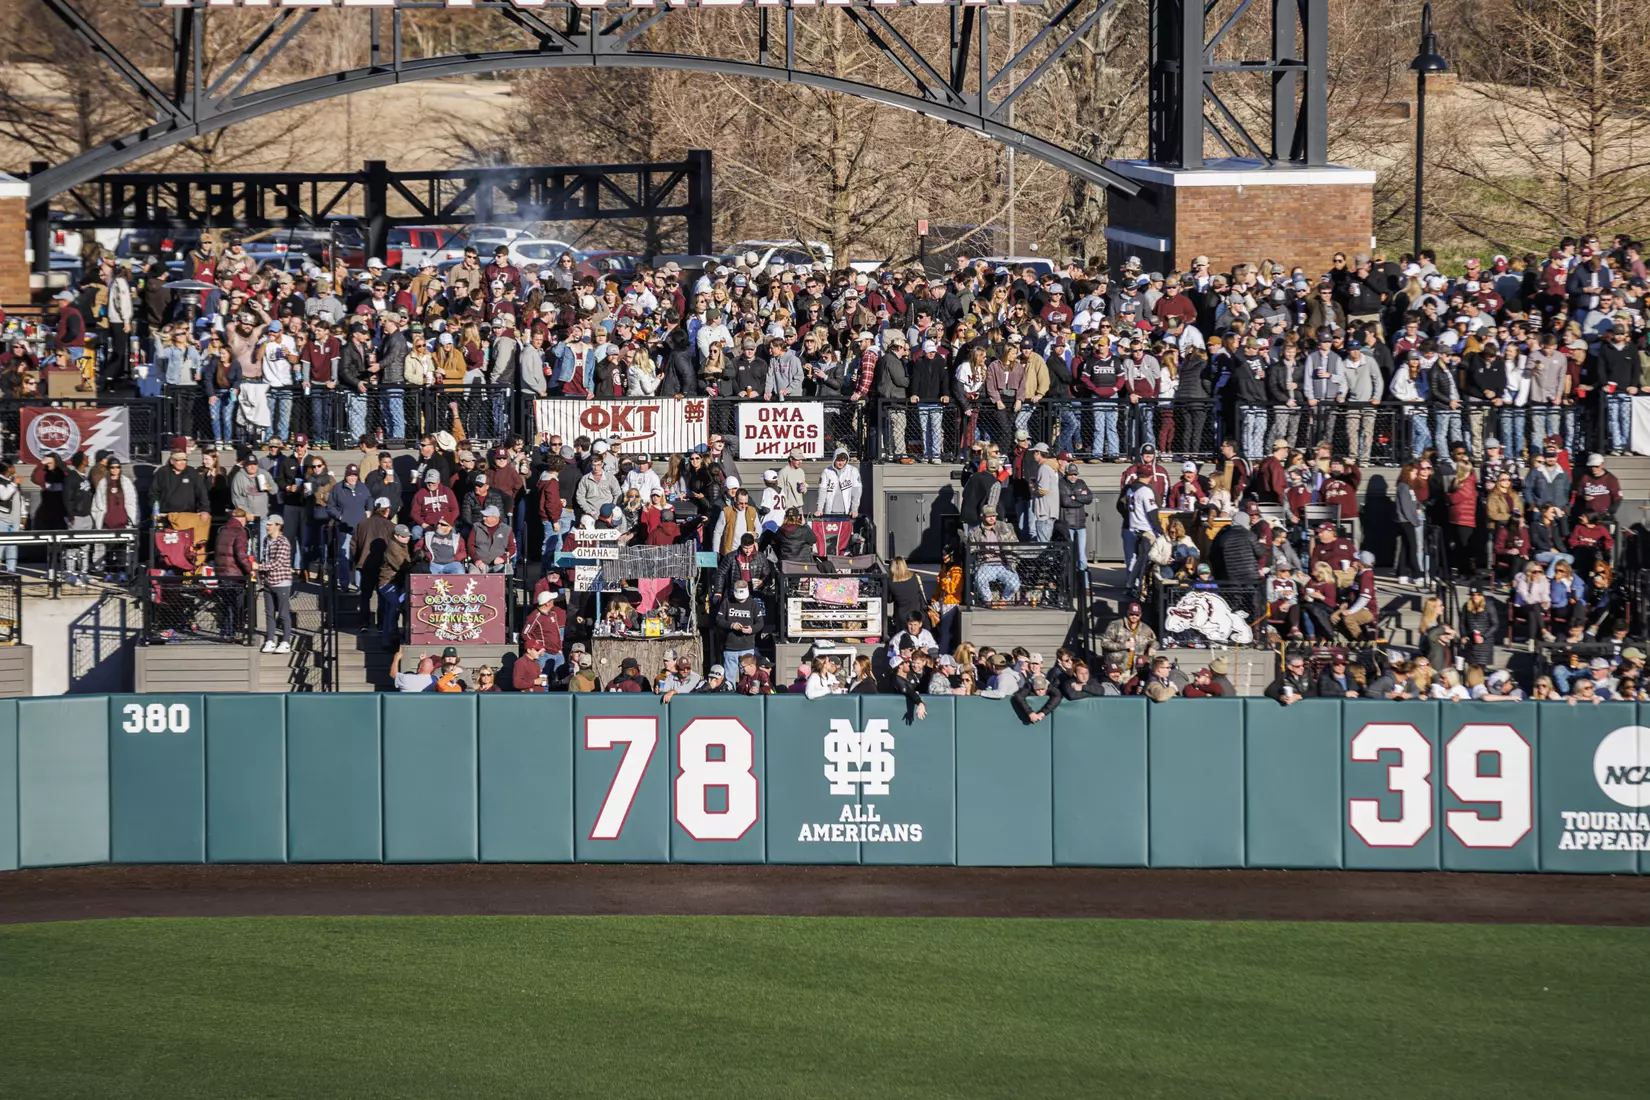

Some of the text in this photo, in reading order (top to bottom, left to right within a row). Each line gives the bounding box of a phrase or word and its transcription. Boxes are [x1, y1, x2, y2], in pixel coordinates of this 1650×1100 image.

[758, 407, 804, 422] OMA
[745, 424, 819, 440] DAWGS
[579, 531, 607, 539] Hoover
[577, 549, 609, 557] OMAHA
[429, 613, 485, 623] STARKVEGAS
[122, 703, 190, 733] 380
[584, 716, 759, 841] 78
[1349, 722, 1532, 849] 39
[839, 804, 880, 822] ALL
[798, 824, 923, 842] AMERICANS
